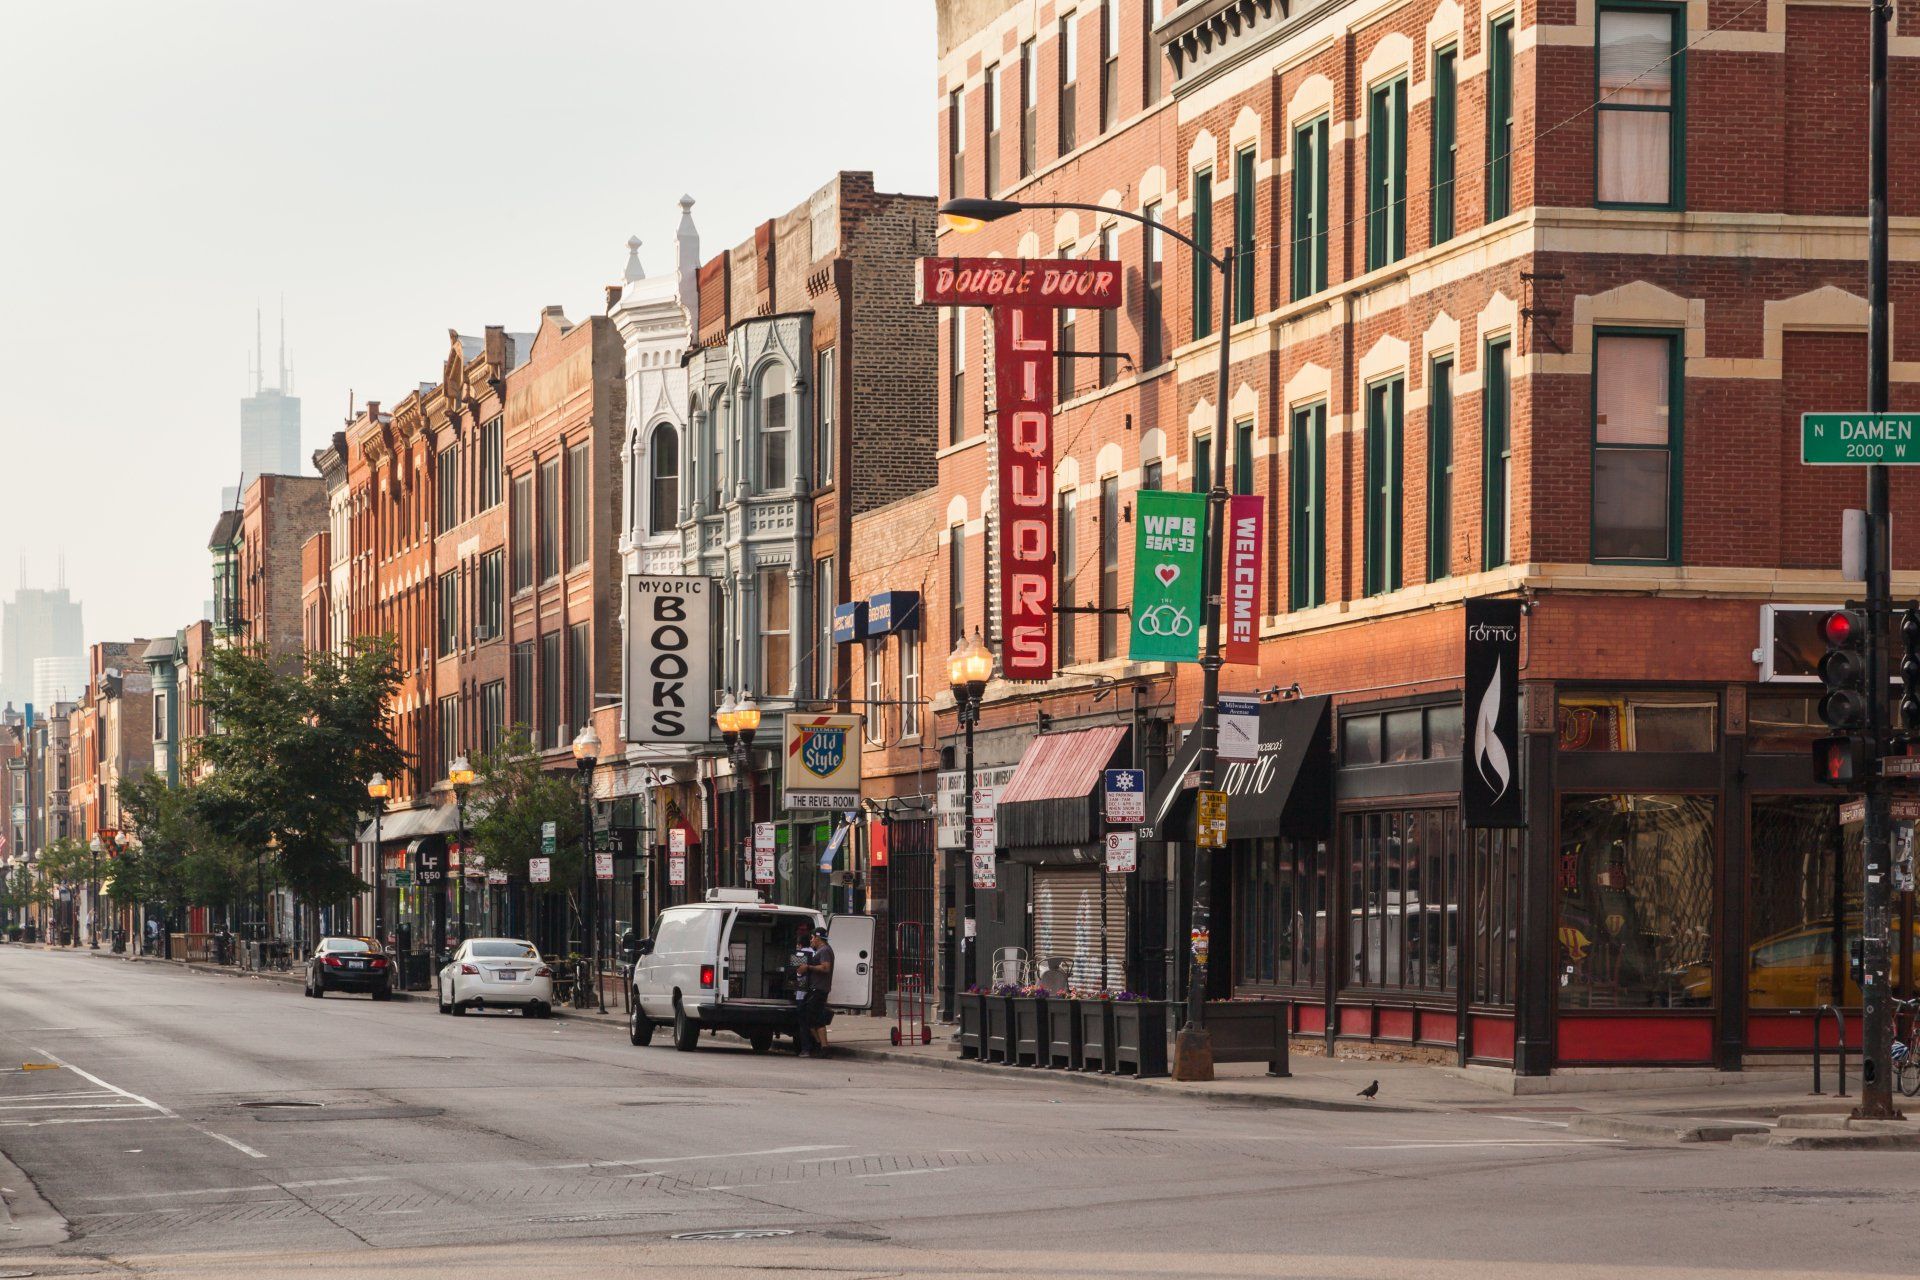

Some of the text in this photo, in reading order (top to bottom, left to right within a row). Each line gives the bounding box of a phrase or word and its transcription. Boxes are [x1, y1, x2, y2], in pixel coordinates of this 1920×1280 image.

[936, 267, 1114, 297] DOUBLE DOOR
[1814, 421, 1912, 440] N DAMEN
[1846, 444, 1906, 457] 2000 W
[1011, 308, 1047, 668] LIQUORS
[1144, 515, 1196, 537] WPB
[638, 581, 702, 593] MYOPIC
[1233, 517, 1256, 643] WELCOME!
[1138, 604, 1193, 637] 606
[650, 596, 689, 737] BOOKS
[813, 734, 837, 750] Old
[806, 748, 840, 772] Style
[793, 796, 855, 807] THE REVEL ROOM
[1139, 828, 1153, 838] 1576
[422, 853, 437, 869] LF
[420, 871, 440, 880] 1550
